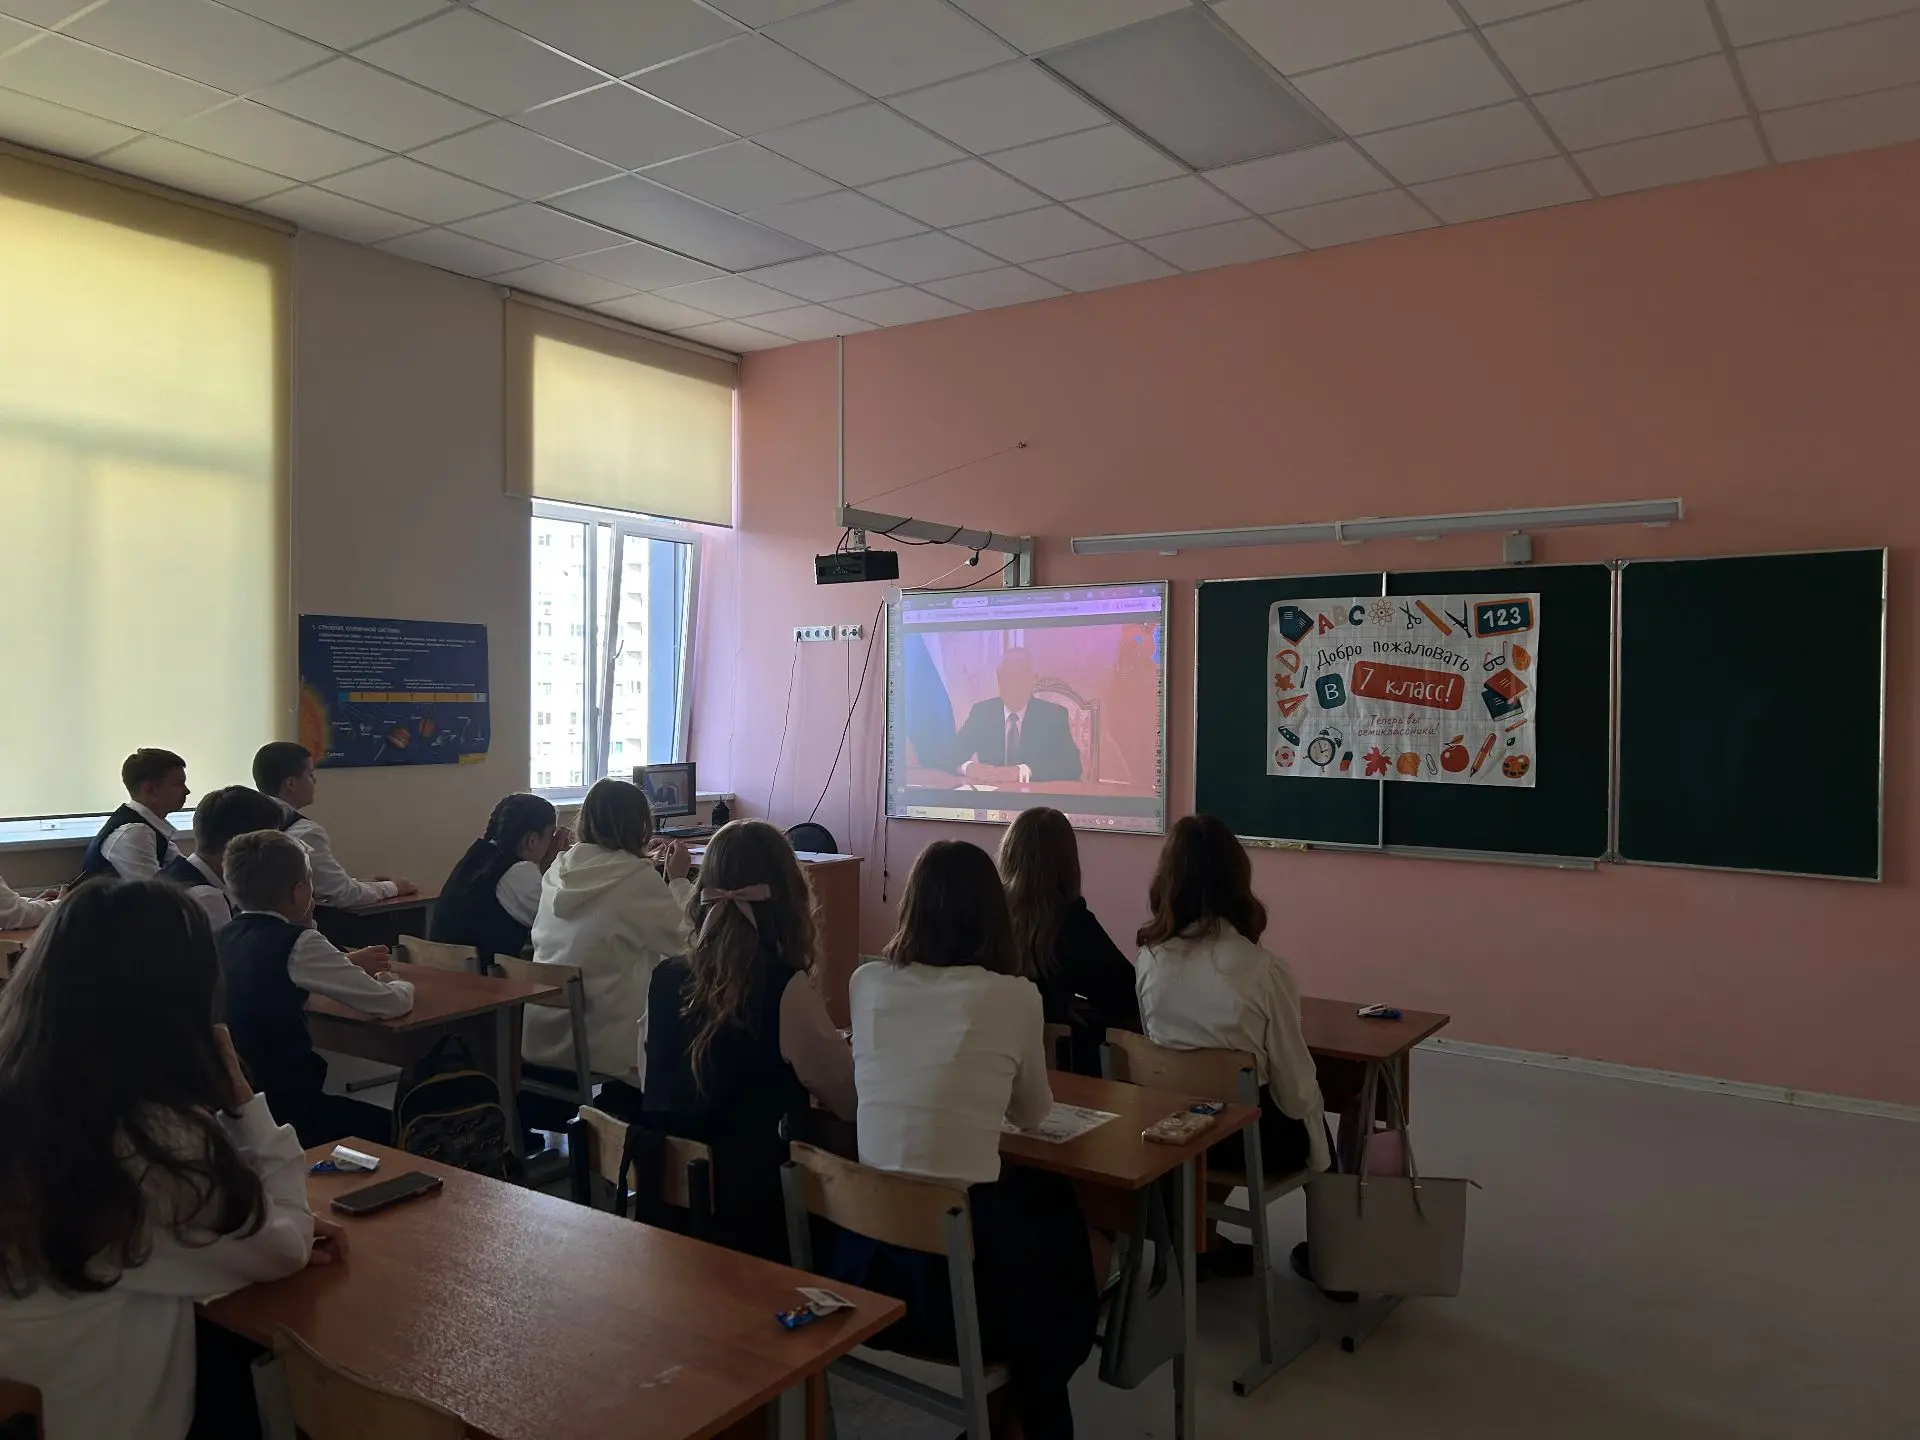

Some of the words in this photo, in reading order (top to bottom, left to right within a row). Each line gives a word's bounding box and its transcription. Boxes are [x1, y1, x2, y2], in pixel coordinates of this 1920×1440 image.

[1483, 606, 1522, 628] 123
[1317, 643, 1362, 670] Добро
[1373, 640, 1470, 672] пожаловать
[1359, 667, 1375, 690] 7
[1386, 678, 1455, 703] класс!
[1357, 723, 1440, 738] семиклассники!
[1370, 714, 1404, 728] Теперь
[1407, 712, 1421, 726] вы
